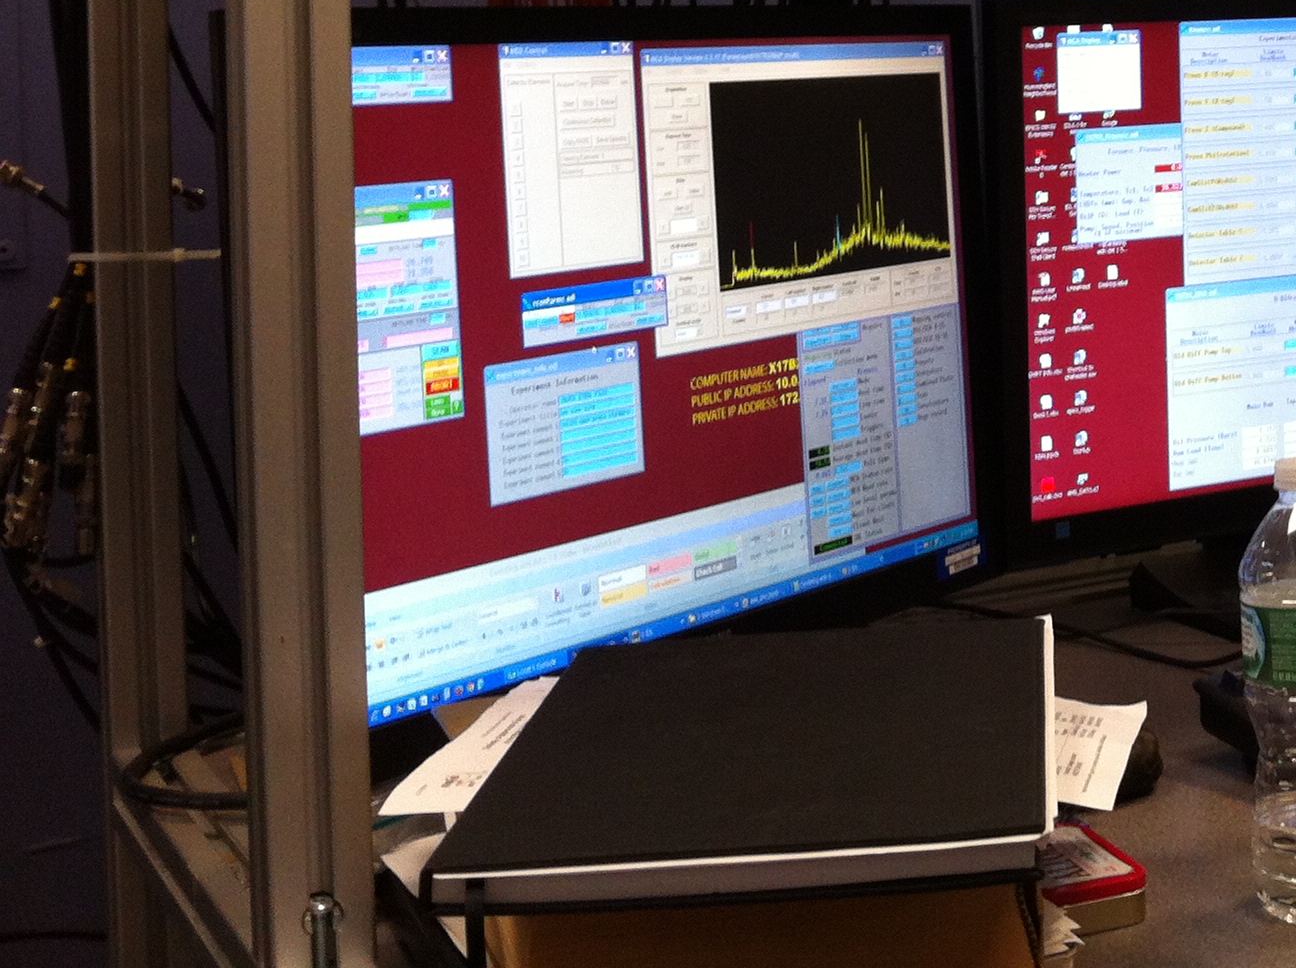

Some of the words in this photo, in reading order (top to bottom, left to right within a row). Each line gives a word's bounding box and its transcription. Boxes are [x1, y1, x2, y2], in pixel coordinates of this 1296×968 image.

[690, 369, 739, 390] COMPUTER
[740, 364, 768, 380] NAME:
[768, 358, 799, 375] X17B
[691, 390, 722, 407] PUBLIC
[724, 387, 732, 402] IP
[692, 406, 726, 428] PRIVATE
[728, 404, 737, 418] IP
